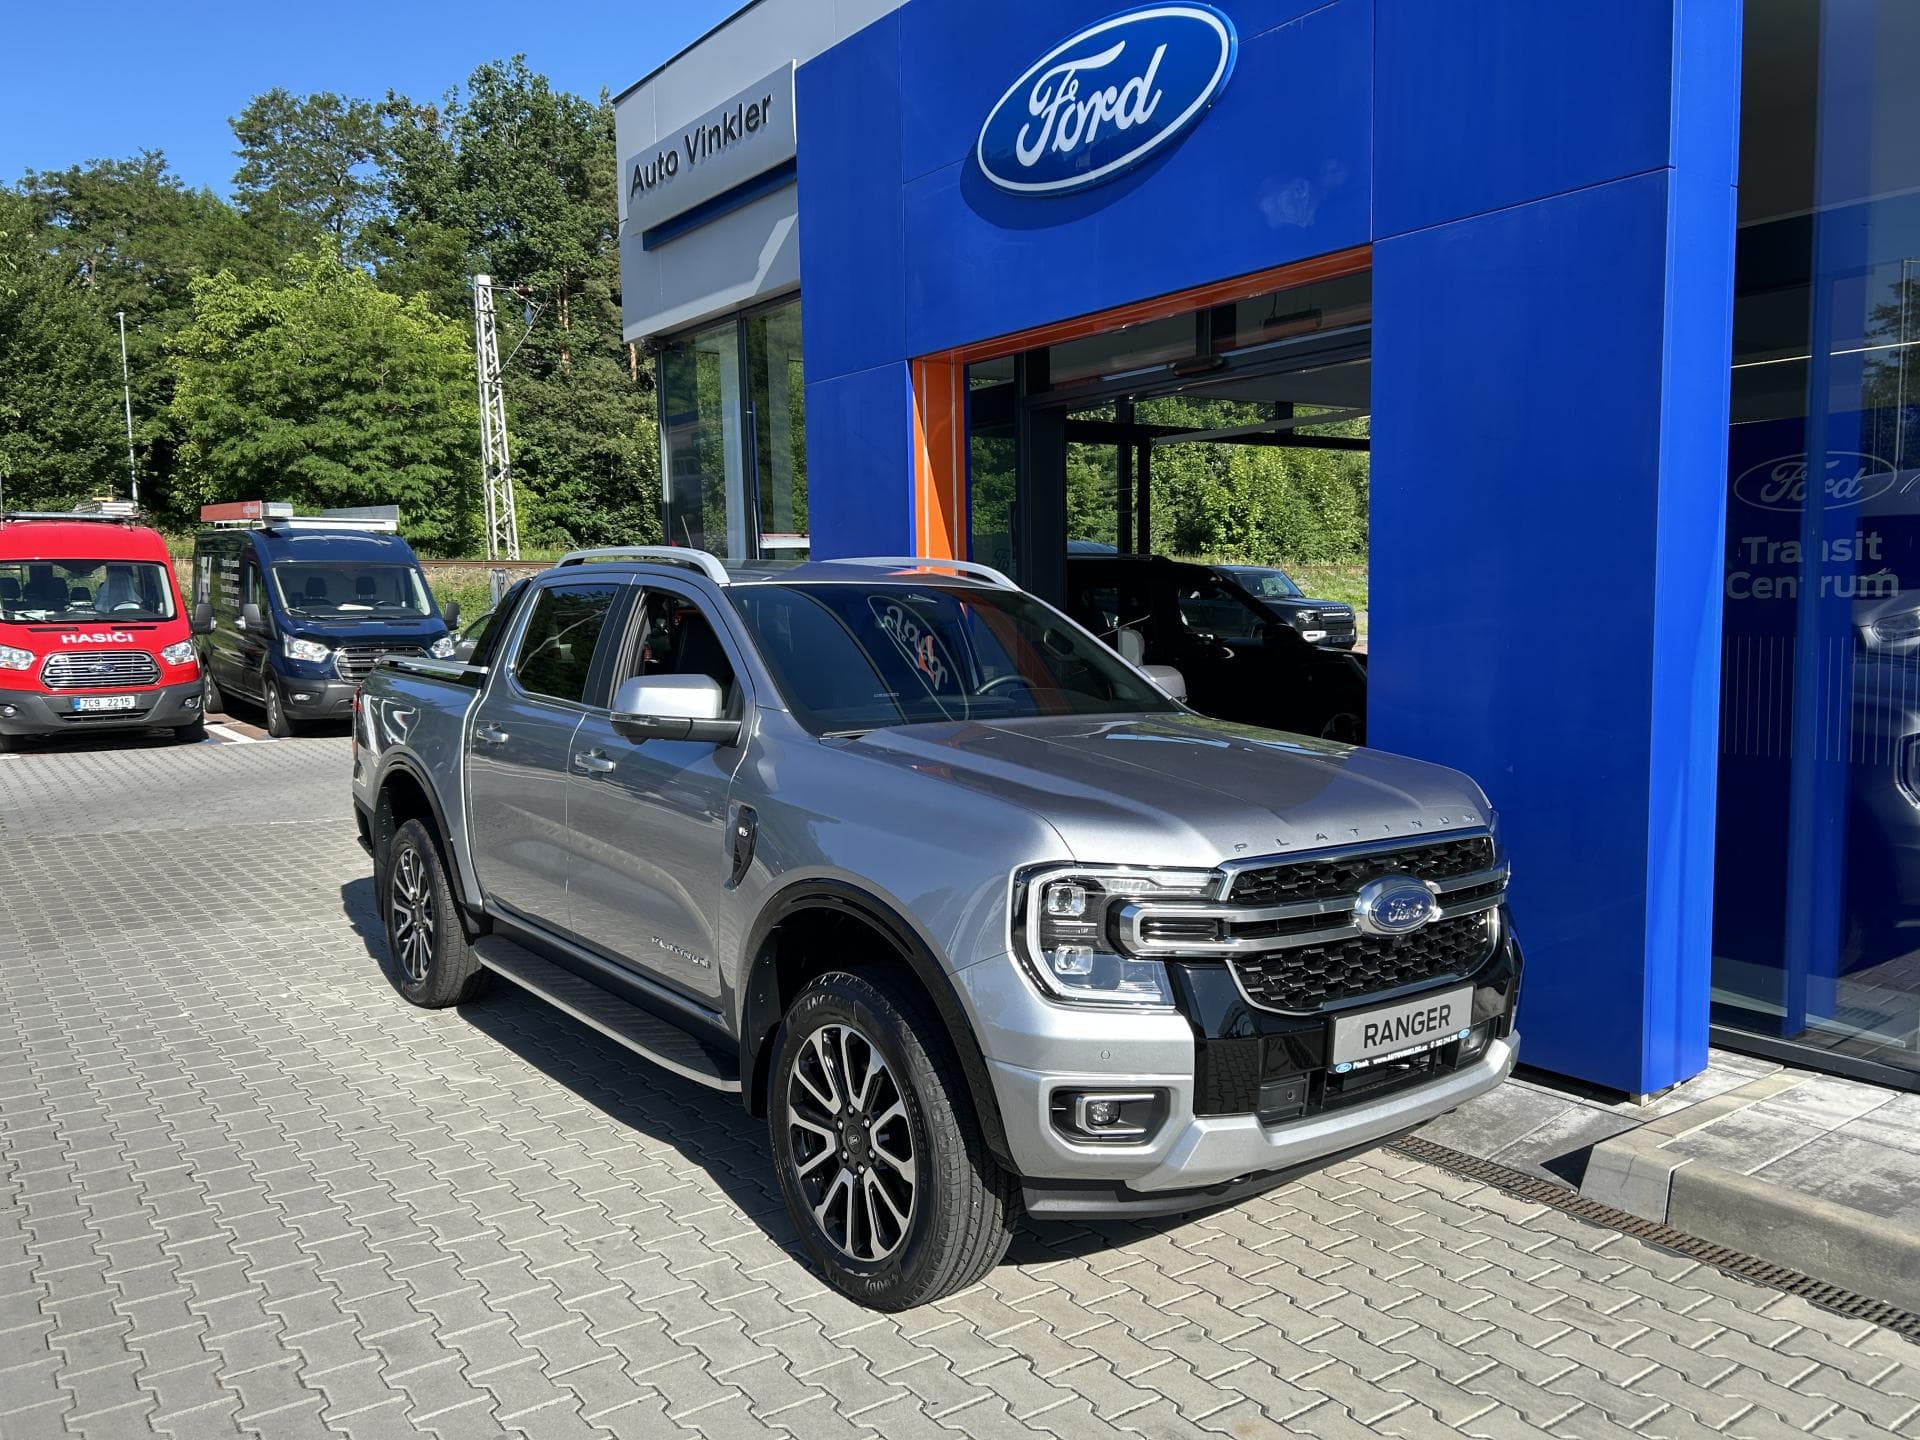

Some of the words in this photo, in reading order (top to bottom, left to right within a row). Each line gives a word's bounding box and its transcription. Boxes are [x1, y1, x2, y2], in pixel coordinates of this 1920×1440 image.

[1015, 39, 1168, 167] Ford
[630, 150, 679, 198] Auto
[684, 93, 772, 165] Vinkler
[1726, 570, 1899, 600] Cenrum
[61, 631, 134, 644] HASIČI
[107, 697, 131, 707] 2215
[1233, 814, 1476, 853] PLATINUM
[1363, 1003, 1451, 1049] RANGER
